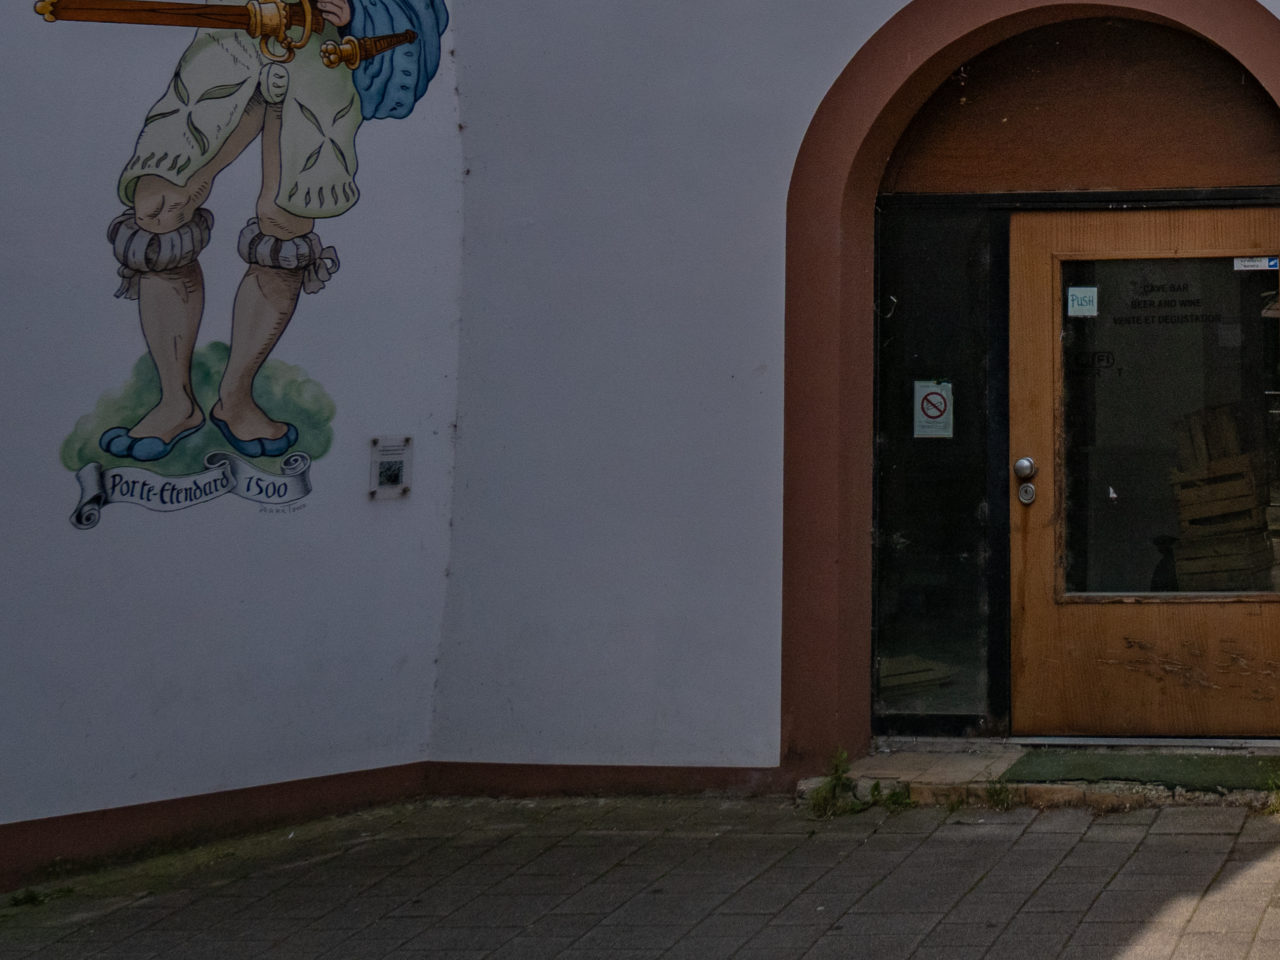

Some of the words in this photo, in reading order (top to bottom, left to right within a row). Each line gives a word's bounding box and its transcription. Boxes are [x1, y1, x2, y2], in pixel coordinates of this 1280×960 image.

[1169, 282, 1189, 292] BAR
[1130, 299, 1154, 309] BEER
[1157, 299, 1177, 308] AND
[1179, 298, 1201, 307] WINE
[1112, 316, 1143, 325] VENTE
[1144, 315, 1156, 324] ET
[245, 476, 288, 498] 1500
